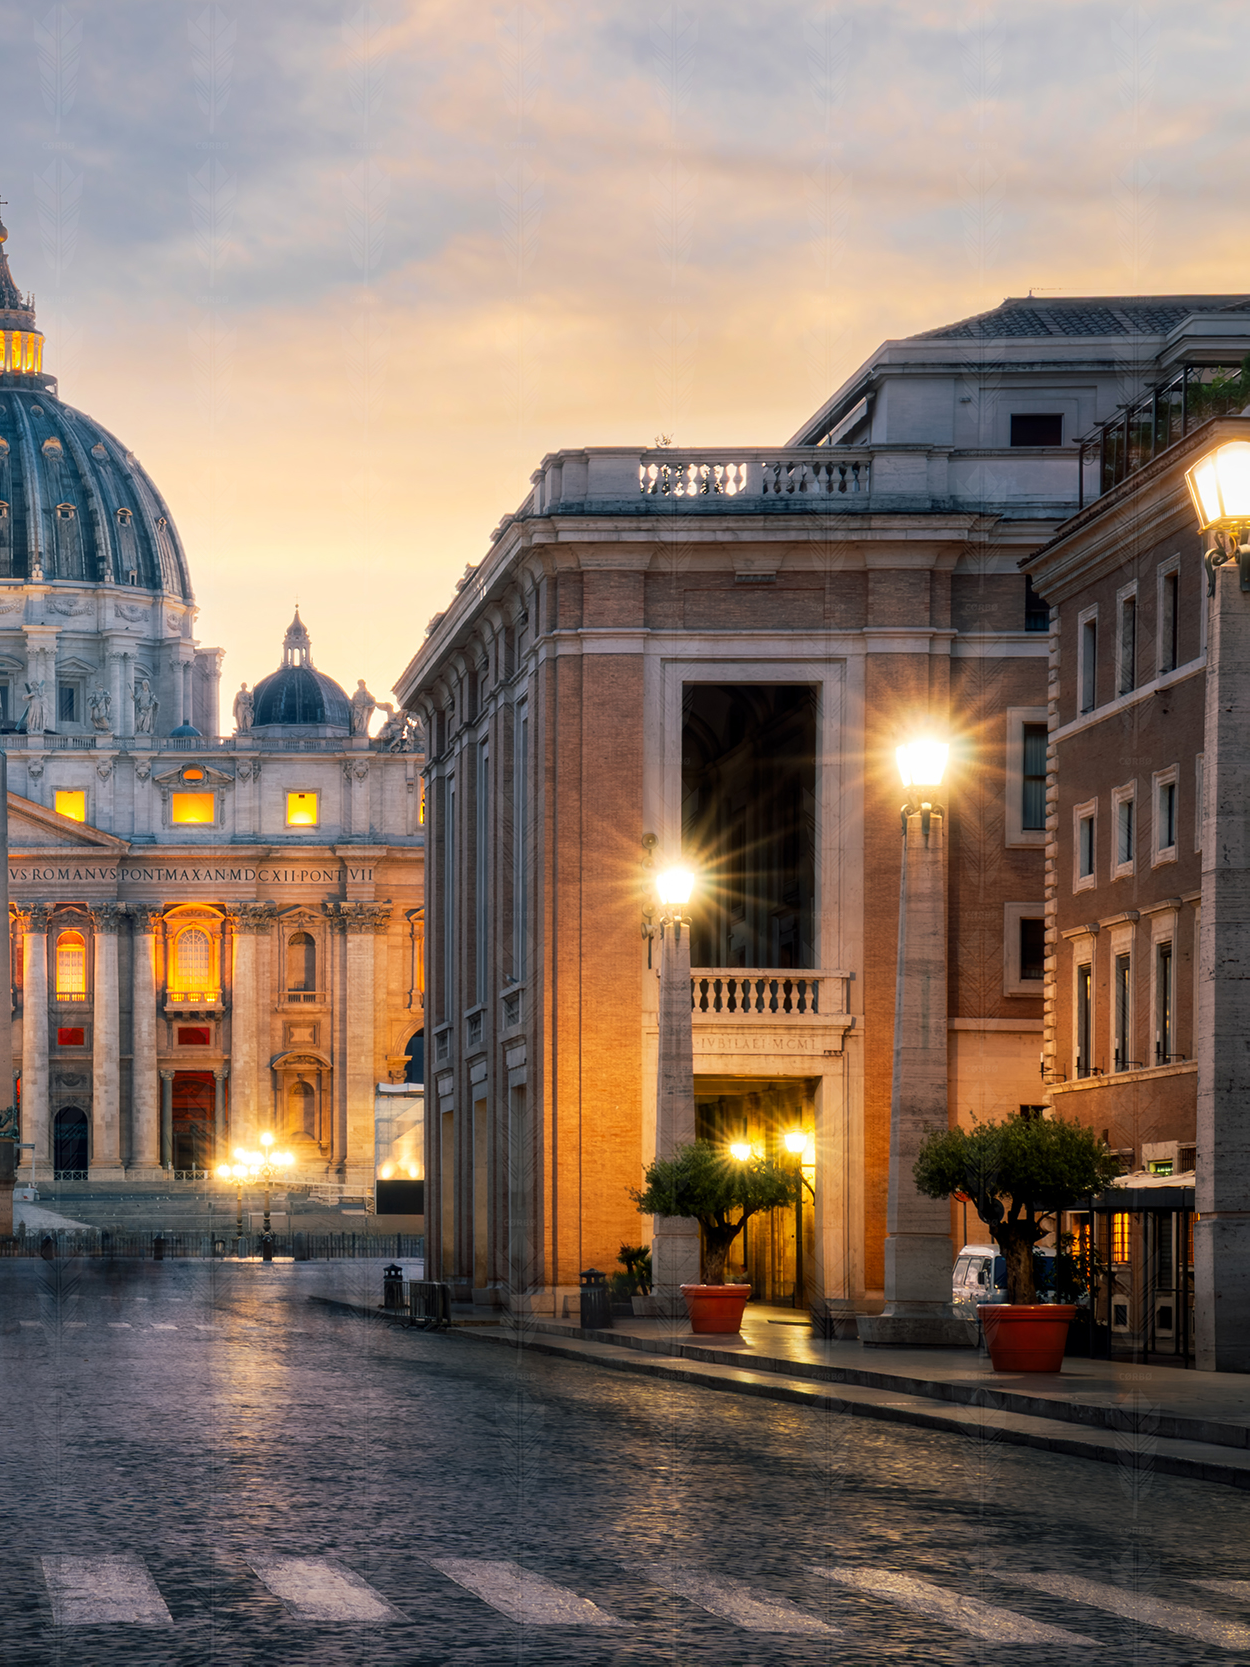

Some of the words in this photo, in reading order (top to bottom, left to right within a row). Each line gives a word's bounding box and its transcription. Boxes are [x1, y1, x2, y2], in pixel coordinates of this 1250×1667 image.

[31, 869, 117, 883] ROMANVS
[120, 869, 163, 883] PONT
[165, 869, 200, 883] MAX
[203, 869, 226, 883] AN
[230, 869, 295, 883] MDCXII
[300, 869, 345, 883] PONT
[349, 869, 374, 883] VII
